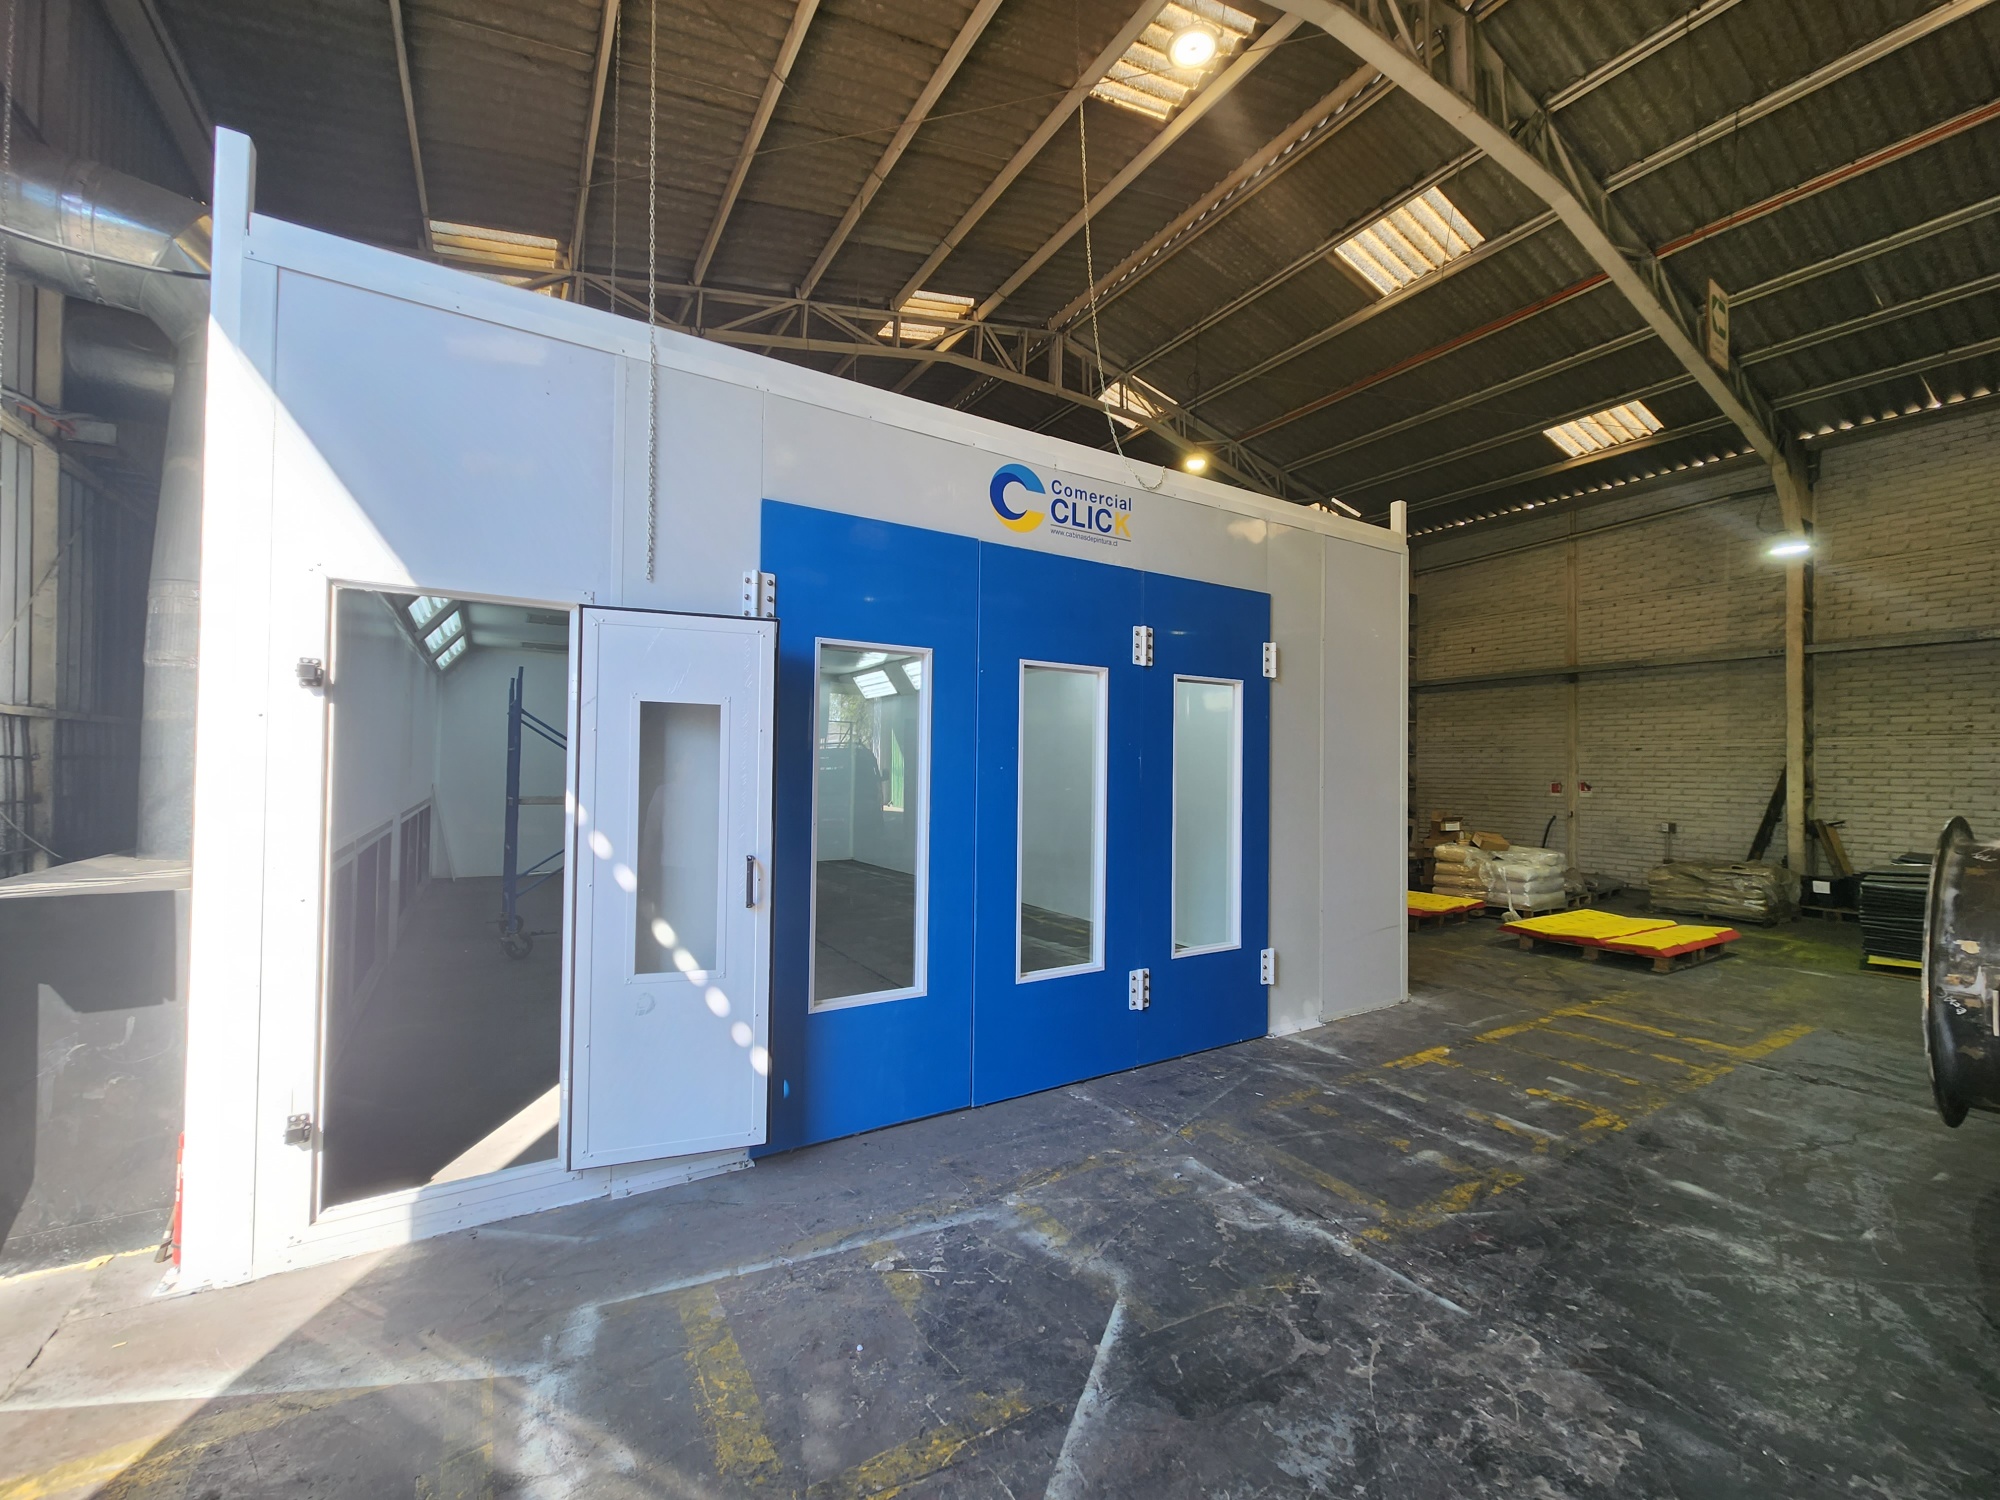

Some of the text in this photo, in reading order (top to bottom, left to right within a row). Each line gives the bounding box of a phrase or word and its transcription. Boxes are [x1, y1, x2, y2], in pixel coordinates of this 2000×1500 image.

[1051, 480, 1132, 511] Comercial
[1050, 498, 1132, 538] CLICK
[1050, 529, 1118, 547] www.cabinasdepintura.cl
